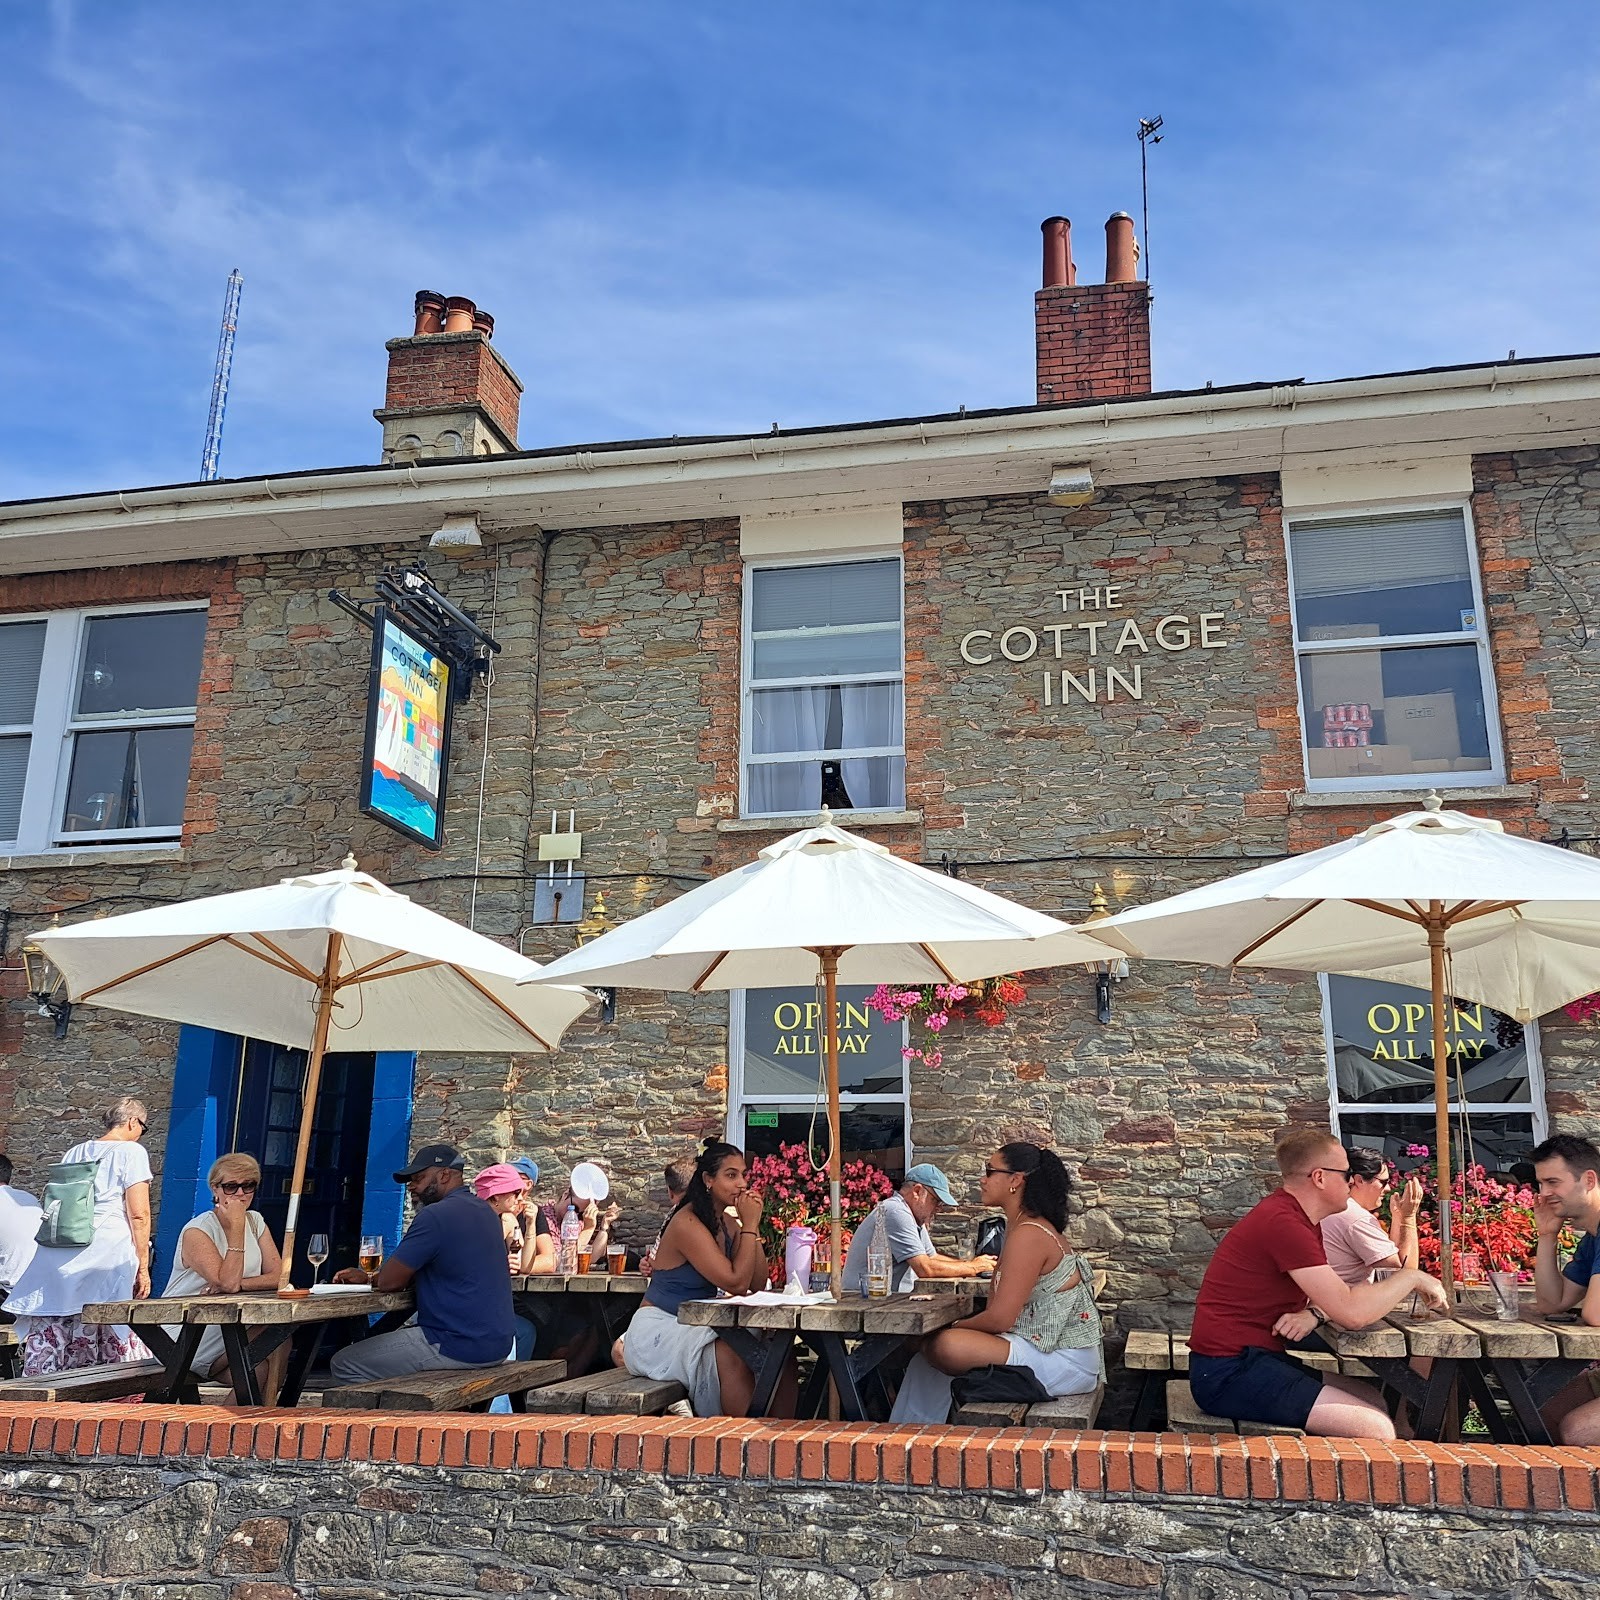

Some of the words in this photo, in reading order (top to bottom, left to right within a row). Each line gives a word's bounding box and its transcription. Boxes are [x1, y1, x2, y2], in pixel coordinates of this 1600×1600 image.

[1055, 585, 1123, 612] THE
[960, 612, 1228, 665] COTTAGE
[411, 647, 423, 662] THE
[391, 646, 439, 693] COTTAGE
[404, 674, 424, 699] INN
[1043, 664, 1142, 706] INN
[773, 1034, 816, 1055] ALL
[1371, 1039, 1422, 1060] ALL
